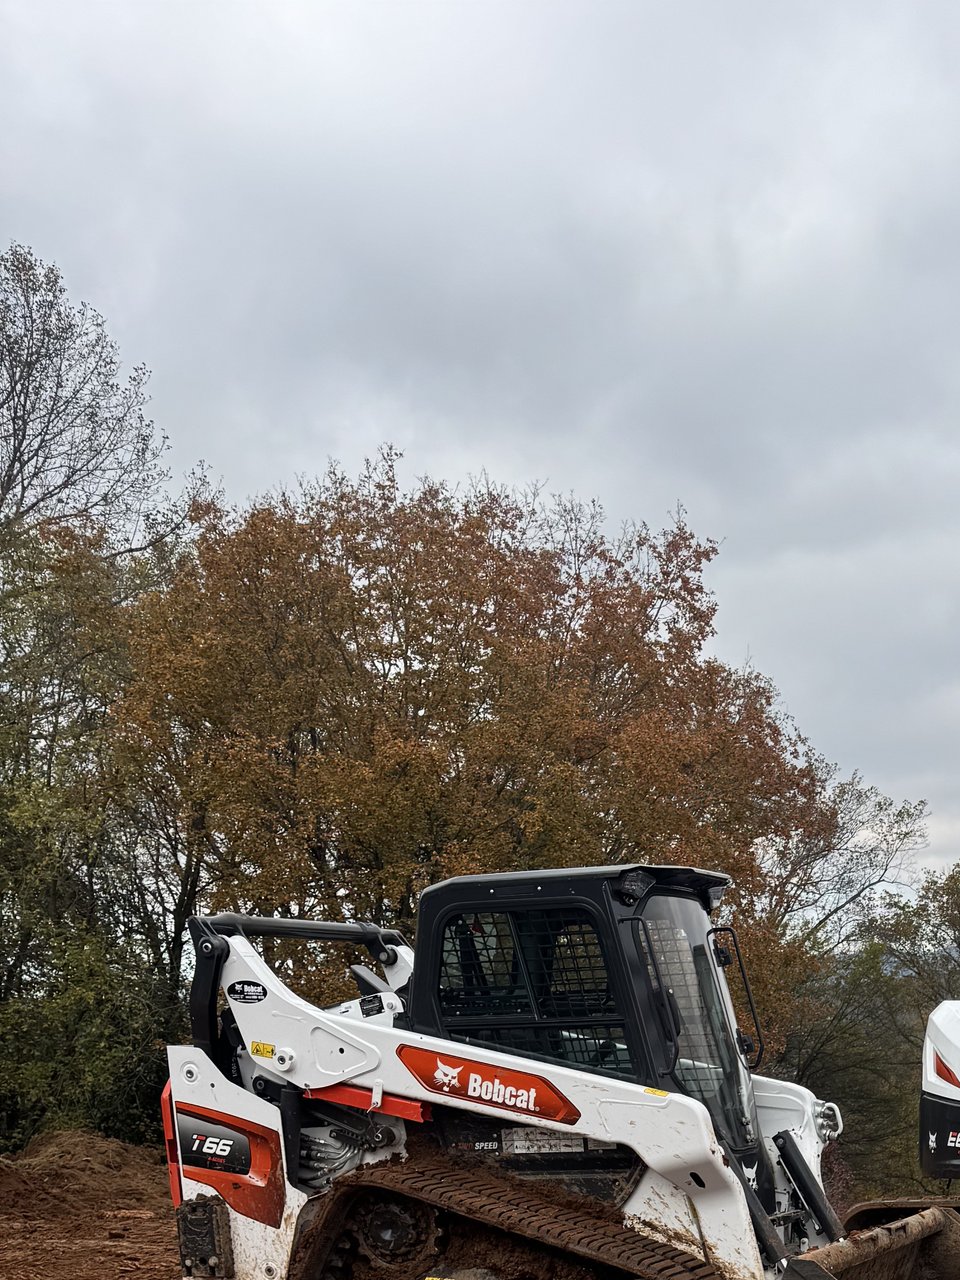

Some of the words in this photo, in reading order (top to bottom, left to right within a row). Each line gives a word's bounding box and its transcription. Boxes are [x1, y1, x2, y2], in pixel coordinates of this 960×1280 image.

[467, 1073, 537, 1111] Bobcat
[192, 1134, 234, 1156] T66
[474, 1142, 498, 1150] SPEED
